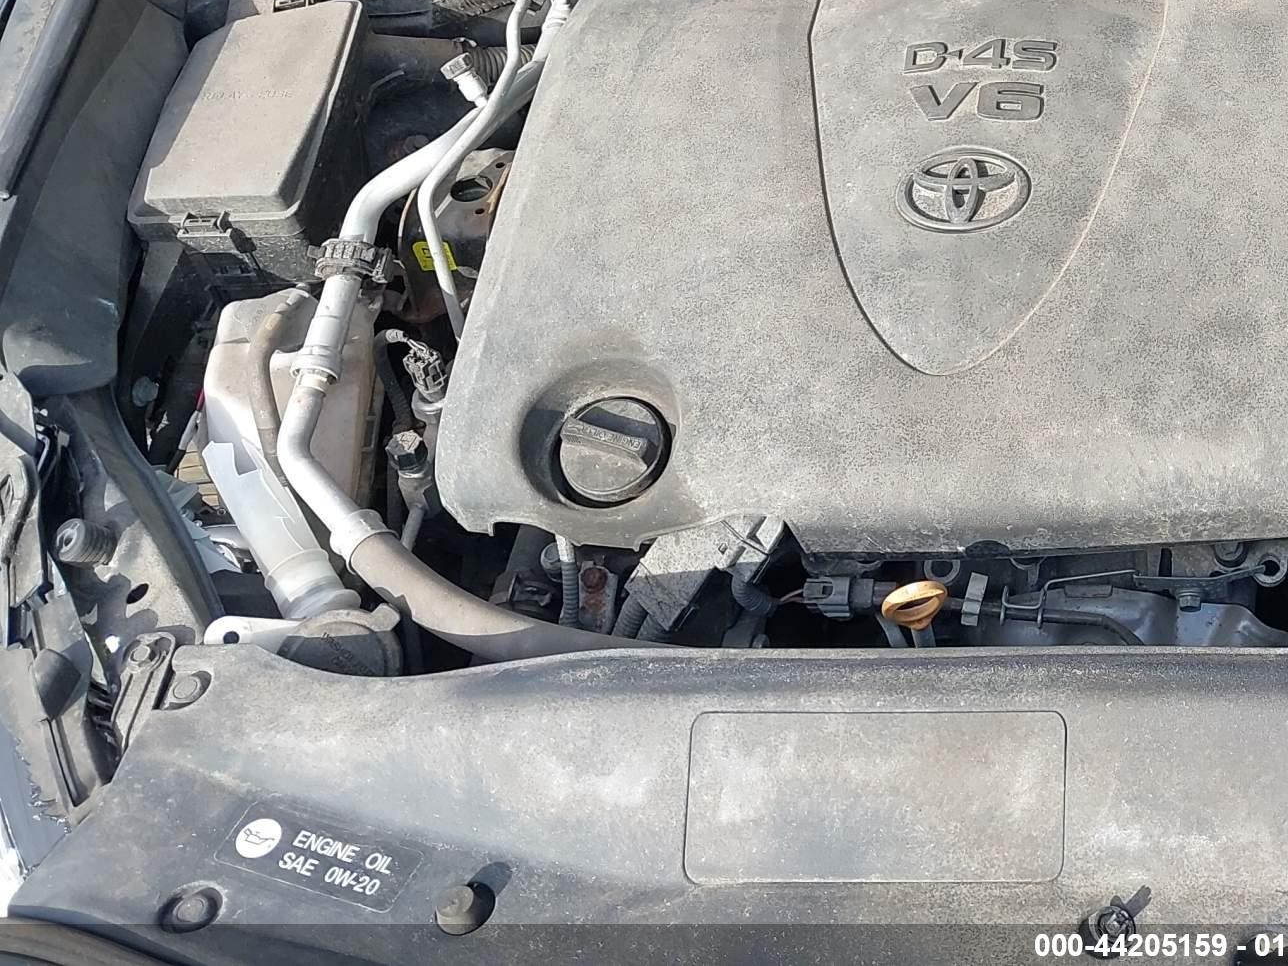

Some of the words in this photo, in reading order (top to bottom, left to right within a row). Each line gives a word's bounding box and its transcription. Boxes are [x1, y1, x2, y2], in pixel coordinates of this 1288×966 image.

[903, 38, 1058, 74] D-4S
[909, 80, 1045, 122] V6
[607, 432, 642, 450] ENGINE
[278, 851, 319, 877] SAE
[323, 865, 381, 896] 0W-20
[292, 829, 360, 864] ENGINE
[364, 852, 393, 876] OIL
